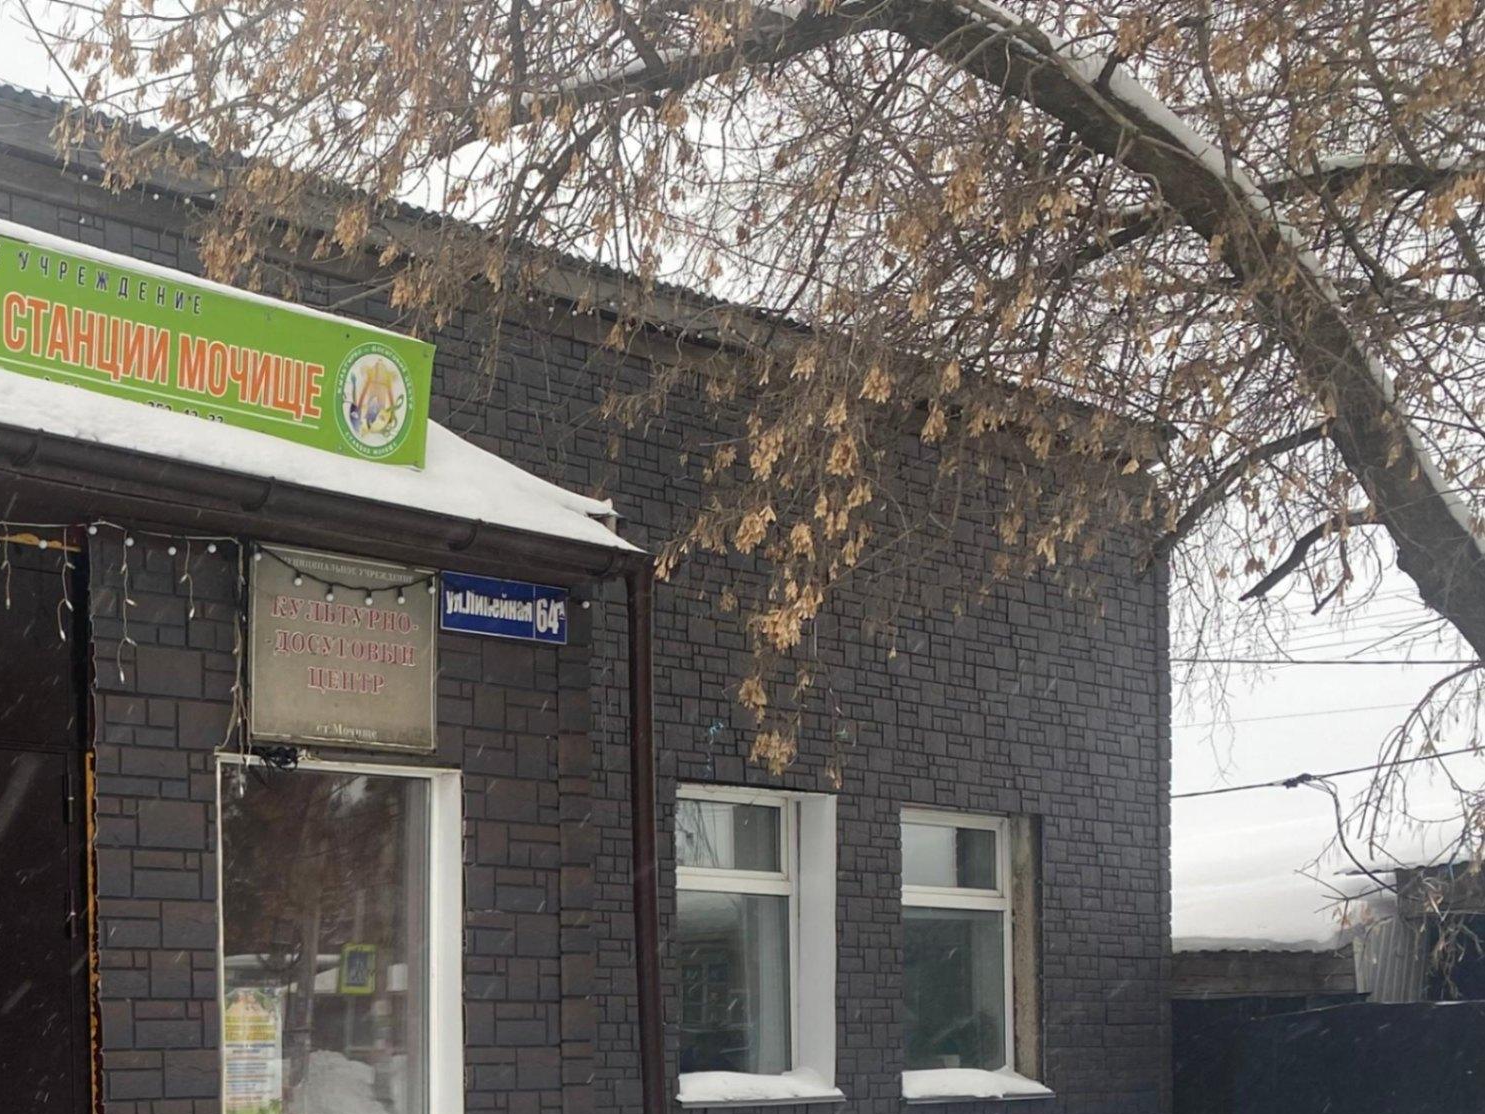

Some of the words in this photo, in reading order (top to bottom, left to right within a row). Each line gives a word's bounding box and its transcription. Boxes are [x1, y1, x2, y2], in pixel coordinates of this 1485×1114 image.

[18, 249, 203, 315] УЧРЕЖДЕНИЕ
[3, 291, 171, 386] СТАНЦИИ
[177, 331, 325, 422] МОЧИЩЕ
[308, 666, 386, 694] ЦЕНТР
